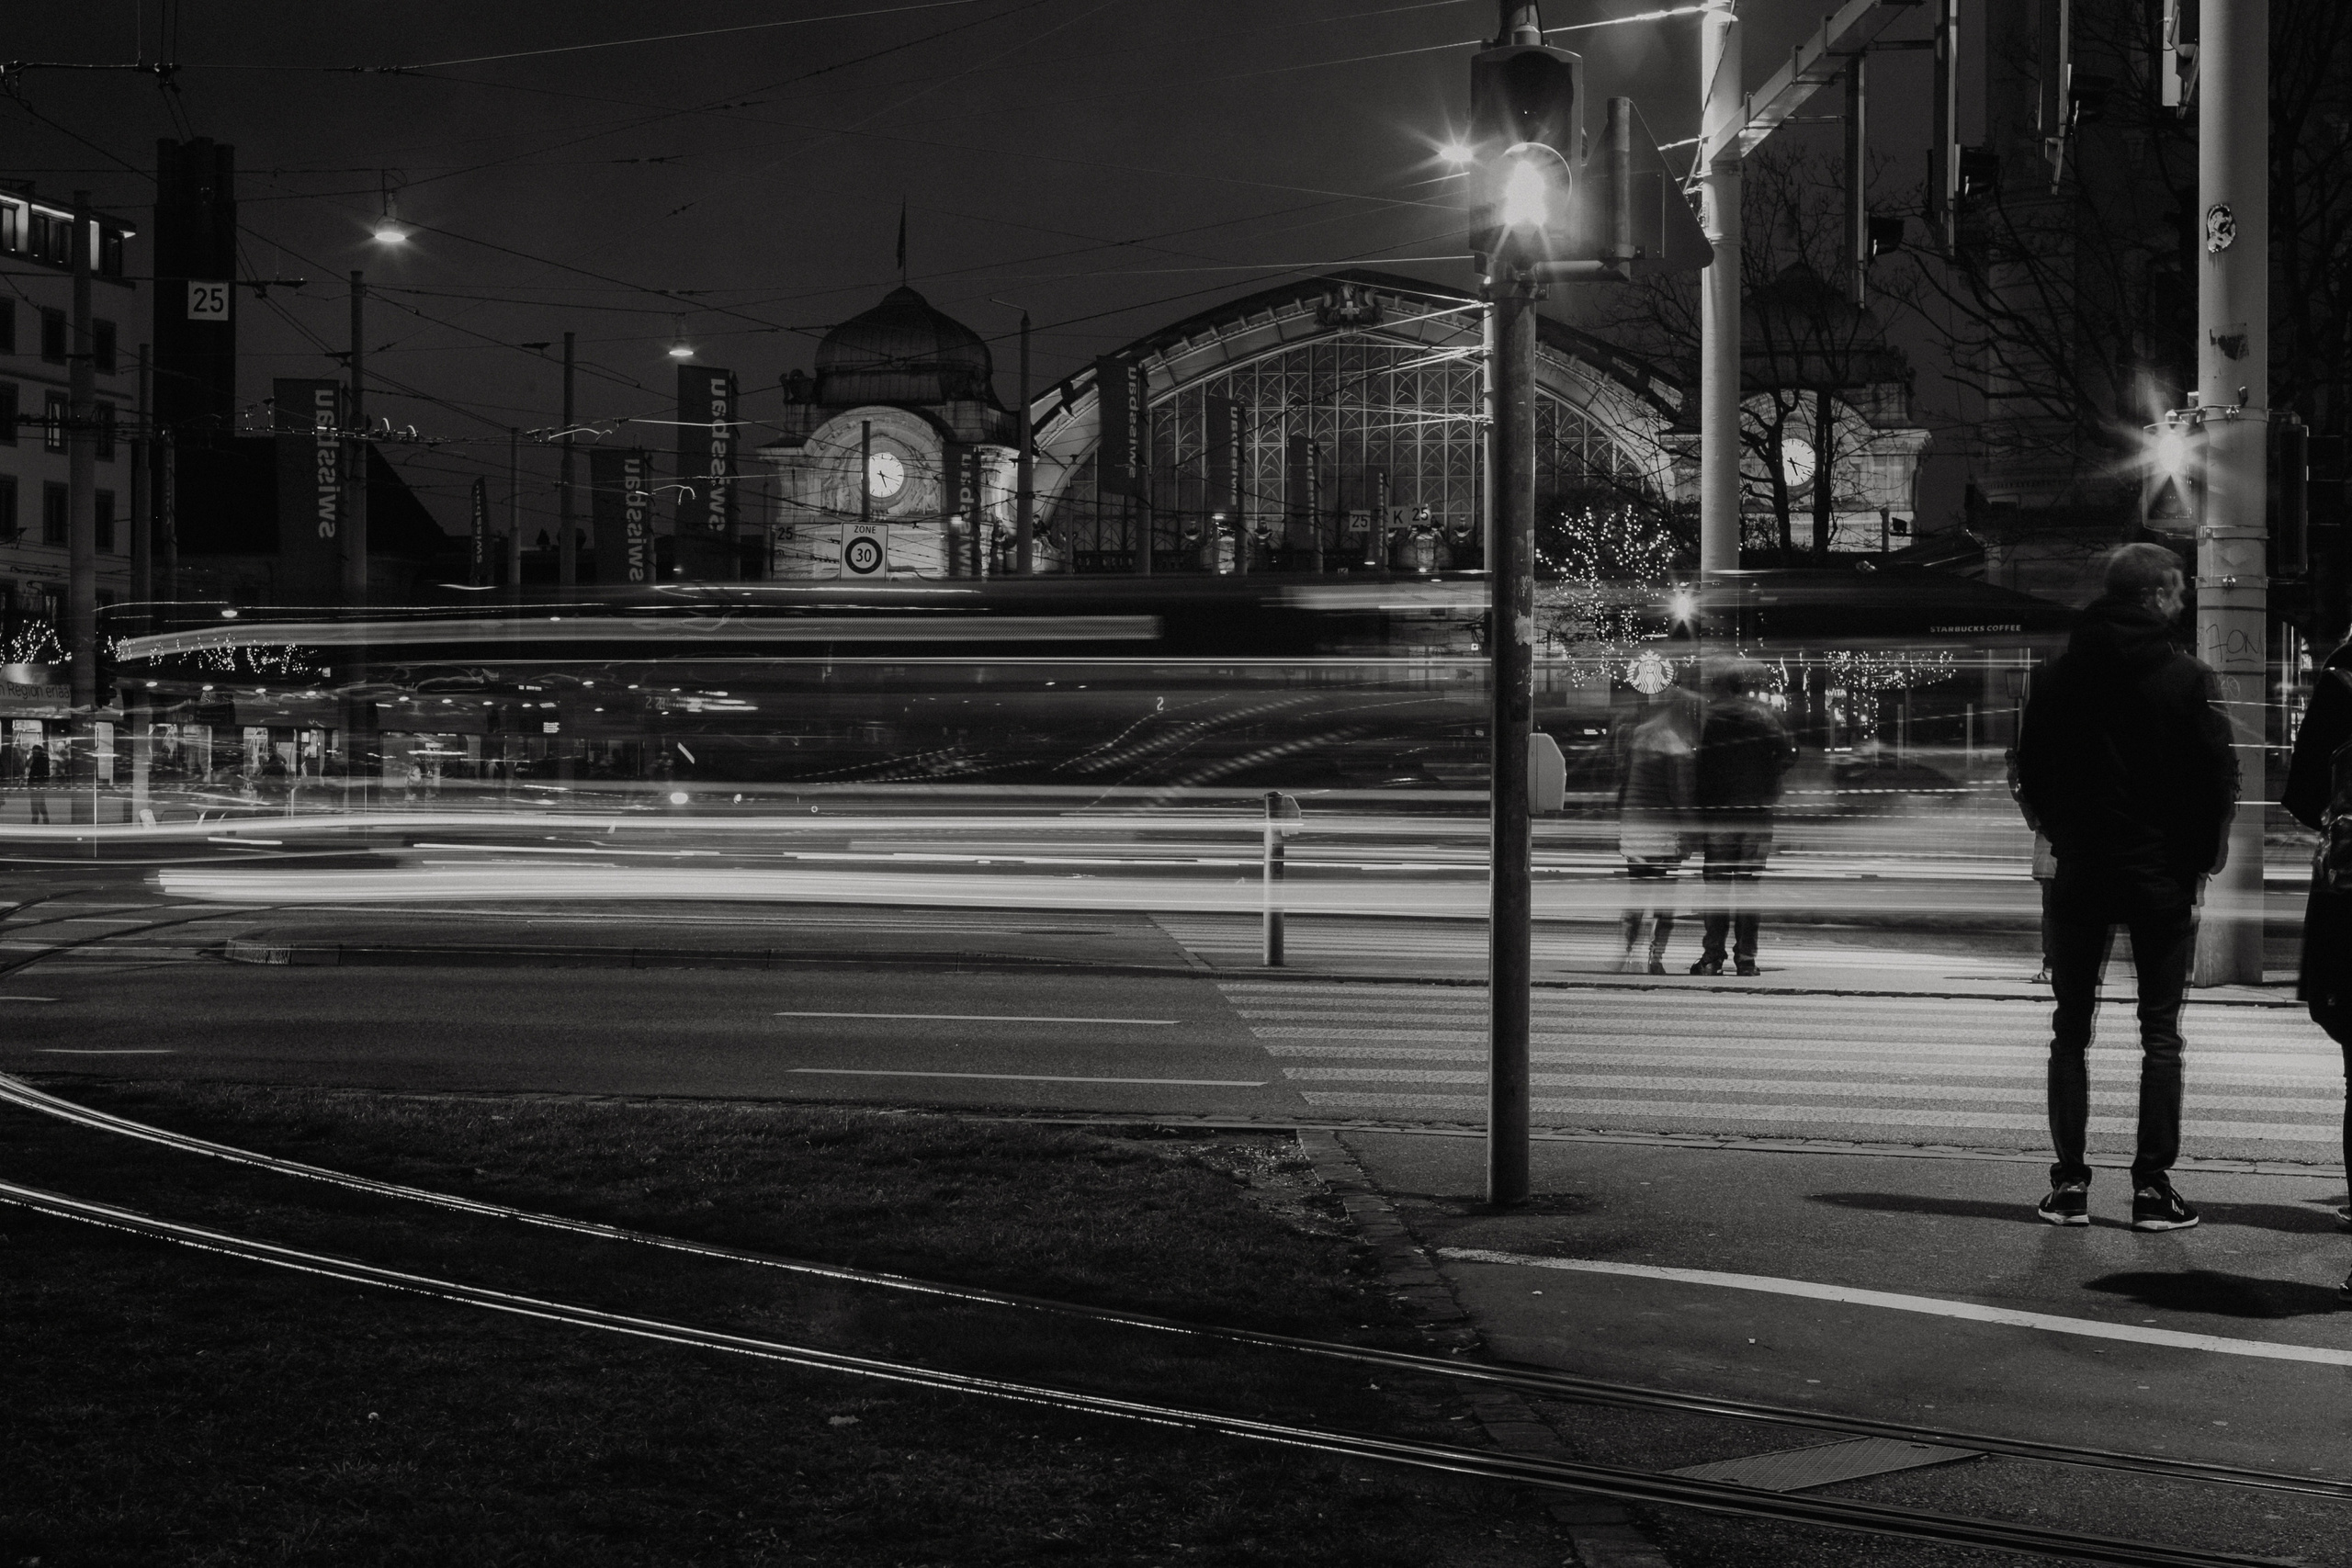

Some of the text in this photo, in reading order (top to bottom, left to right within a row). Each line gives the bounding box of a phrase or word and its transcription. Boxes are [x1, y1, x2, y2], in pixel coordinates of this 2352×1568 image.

[193, 288, 224, 313] 25
[1351, 514, 1368, 528] 25
[1393, 510, 1404, 525] K
[1412, 507, 1430, 521] 25
[777, 526, 794, 541] 25
[854, 525, 876, 534] ZONE
[855, 548, 872, 562] 30
[1929, 625, 1984, 633] STARBUCKS
[6, 681, 43, 701] Region
